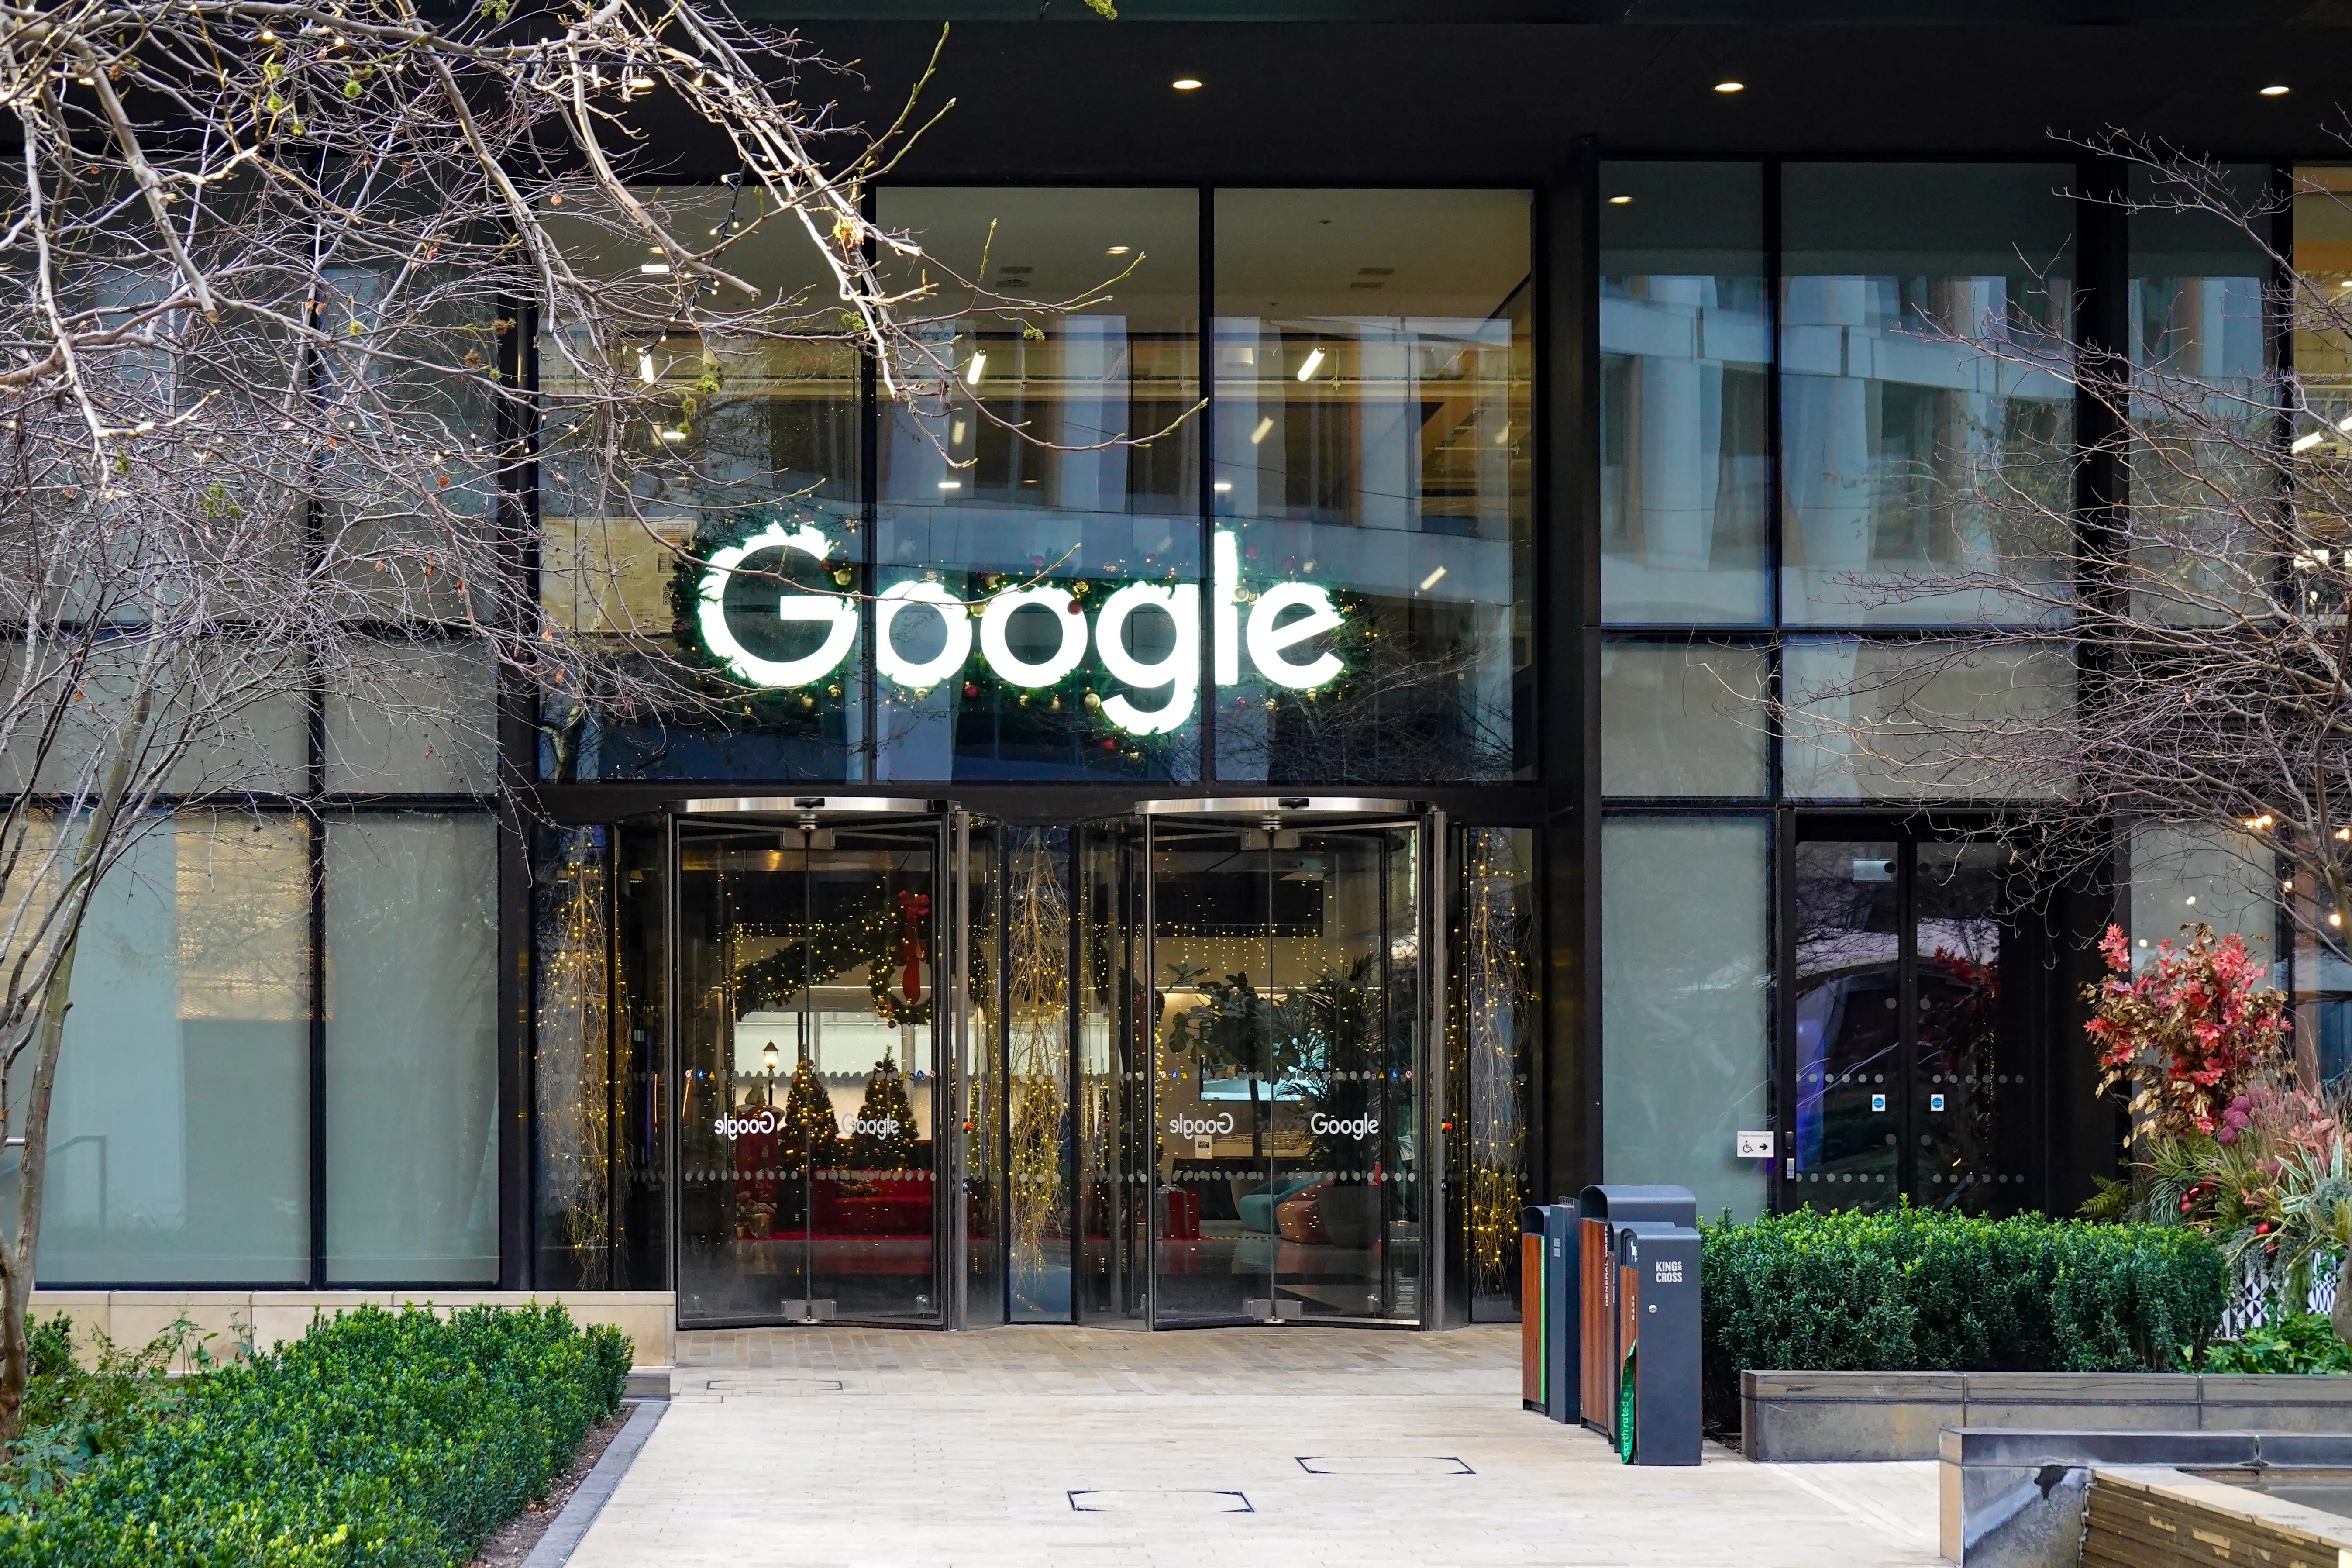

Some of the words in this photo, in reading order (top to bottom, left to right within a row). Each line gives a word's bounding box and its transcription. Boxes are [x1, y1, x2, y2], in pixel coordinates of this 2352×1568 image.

[698, 521, 1345, 735] Google
[842, 1113, 899, 1140] Google
[1311, 1112, 1379, 1140] Google
[1656, 1261, 1682, 1272] KINGS
[1656, 1272, 1683, 1283] CROSS
[1621, 1401, 1629, 1428] rated
[1621, 1430, 1629, 1457] earth
